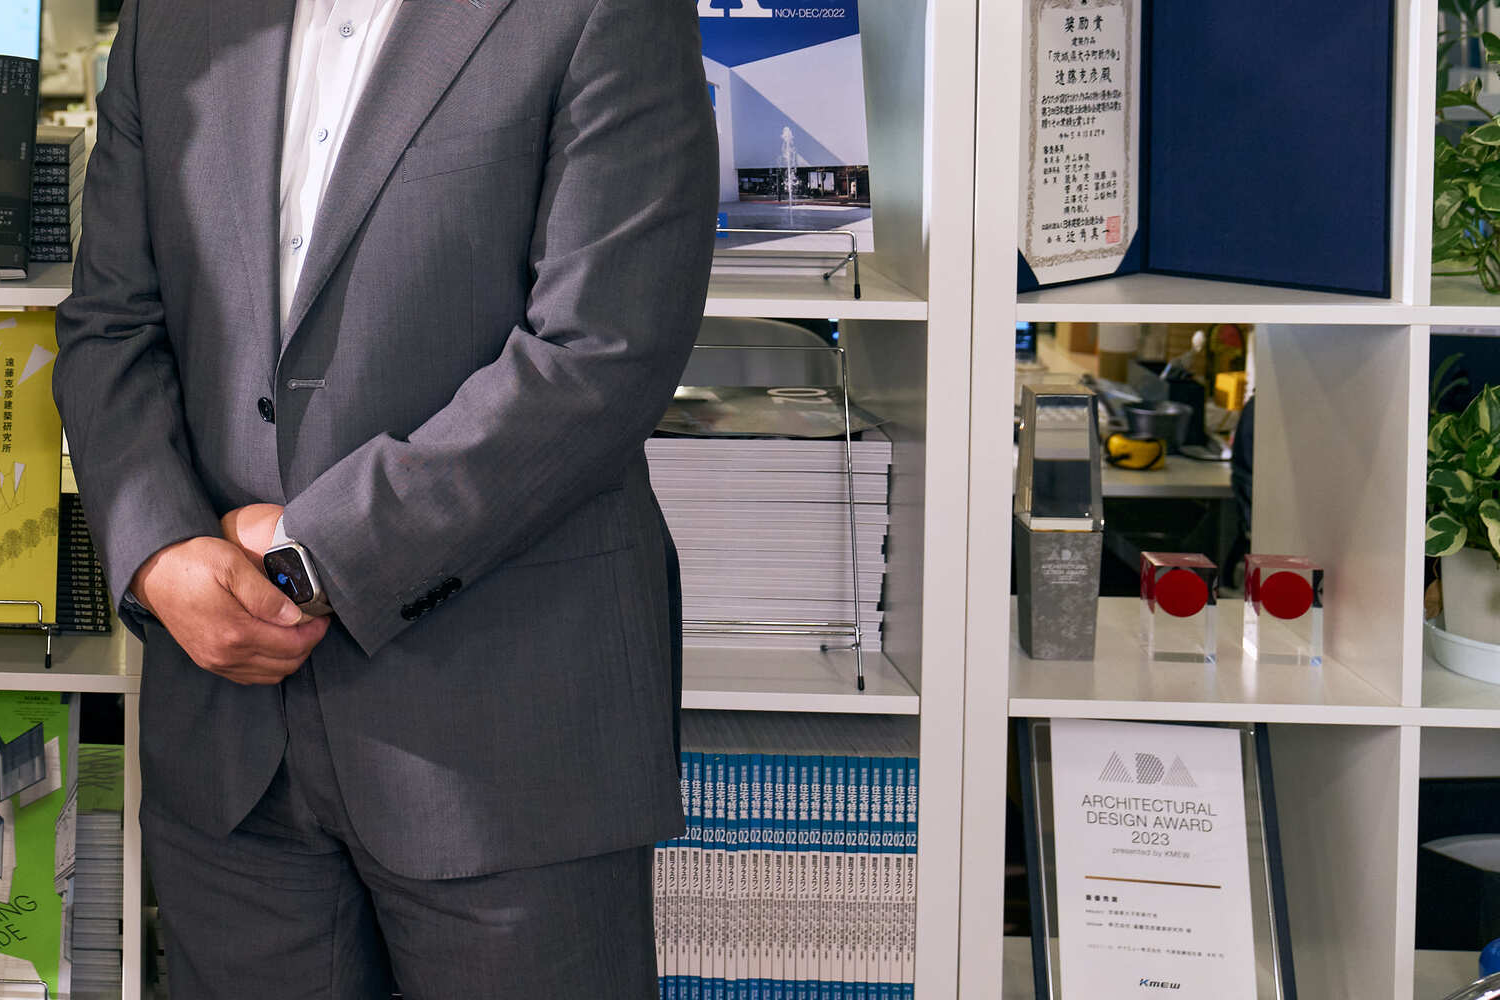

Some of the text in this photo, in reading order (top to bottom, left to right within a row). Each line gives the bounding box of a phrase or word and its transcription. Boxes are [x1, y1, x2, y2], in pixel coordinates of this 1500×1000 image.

[1, 357, 16, 454] 遠藤克彦建築研究所
[691, 780, 701, 817] 住宅特集
[703, 782, 713, 819] 住宅特集
[715, 782, 725, 818] 住宅特集
[726, 784, 736, 821] 住宅特集
[739, 782, 749, 820] 住宅特集
[751, 782, 761, 819] 住宅特集
[763, 782, 773, 819] 住宅特集
[774, 783, 784, 820] 住宅特集
[786, 784, 796, 820] 住宅特集
[799, 784, 809, 821] 住宅特集
[810, 783, 820, 820] 住宅特集
[822, 784, 832, 821] 住宅特集
[834, 784, 844, 821] 住宅特集
[847, 785, 857, 822] 住宅特集
[859, 785, 869, 822] 住宅特集
[871, 786, 881, 822] 住宅特集
[883, 785, 893, 822] 住宅特集
[894, 786, 904, 823] 住宅特集
[906, 786, 916, 823] 住宅特集
[1081, 794, 1218, 817] ARCHITECTURAL
[1086, 810, 1213, 833] DESIGN AWARD
[690, 827, 702, 841] 02
[703, 829, 714, 843] 02
[714, 829, 726, 842] 02
[726, 831, 737, 845] 02
[738, 830, 749, 844] 02
[750, 830, 761, 843] 02
[762, 830, 773, 843] 02
[774, 831, 784, 844] 02
[786, 831, 797, 844] 02
[798, 831, 809, 845] 02
[810, 831, 820, 844] 02
[822, 832, 833, 845] 02
[834, 832, 845, 845] 02
[846, 833, 857, 846] 02
[858, 832, 869, 846] 02
[870, 833, 881, 846] 02
[882, 833, 894, 846] 02
[894, 833, 905, 847] 02
[906, 833, 917, 847] 02
[1131, 830, 1171, 846] 2023
